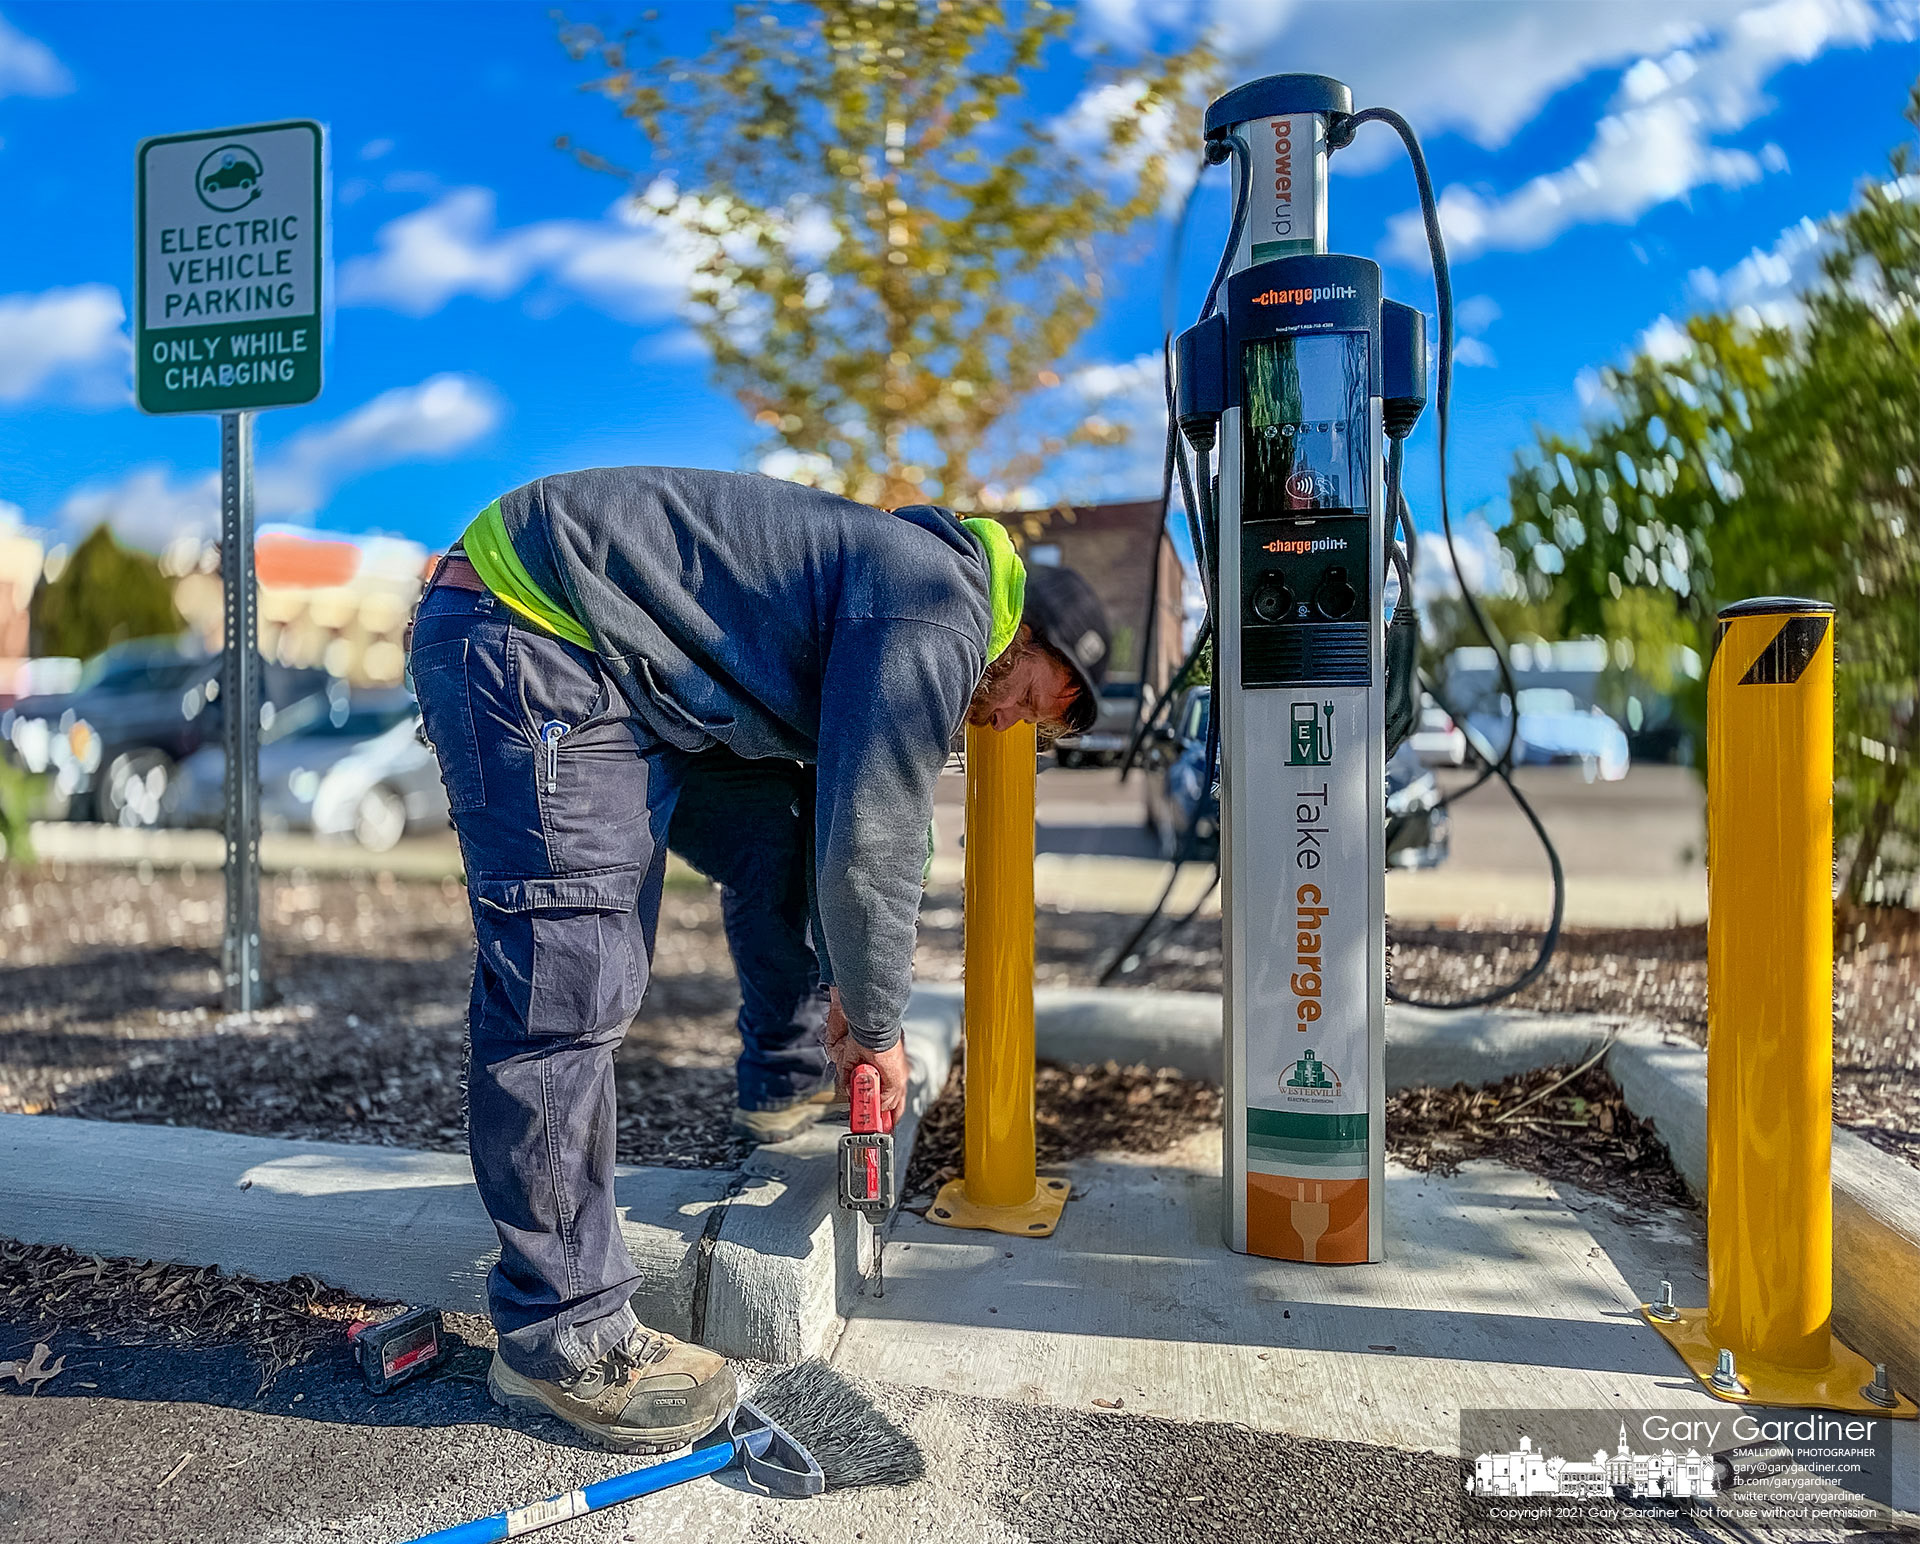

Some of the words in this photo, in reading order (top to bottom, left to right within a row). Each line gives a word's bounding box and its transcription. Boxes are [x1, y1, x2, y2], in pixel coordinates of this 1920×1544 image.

[160, 215, 299, 254] ELECTRIC
[167, 249, 293, 286] VEHICLE
[165, 282, 295, 319] PARKING
[1252, 283, 1357, 306] chargepoint
[152, 336, 221, 363] ONLY
[231, 329, 308, 358] WHILE
[165, 358, 295, 390] CHARGING
[1262, 536, 1348, 555] chargepoint
[1296, 783, 1330, 870] Take
[1290, 883, 1330, 1033] charge.
[1279, 1086, 1342, 1097] WESTERVILLE
